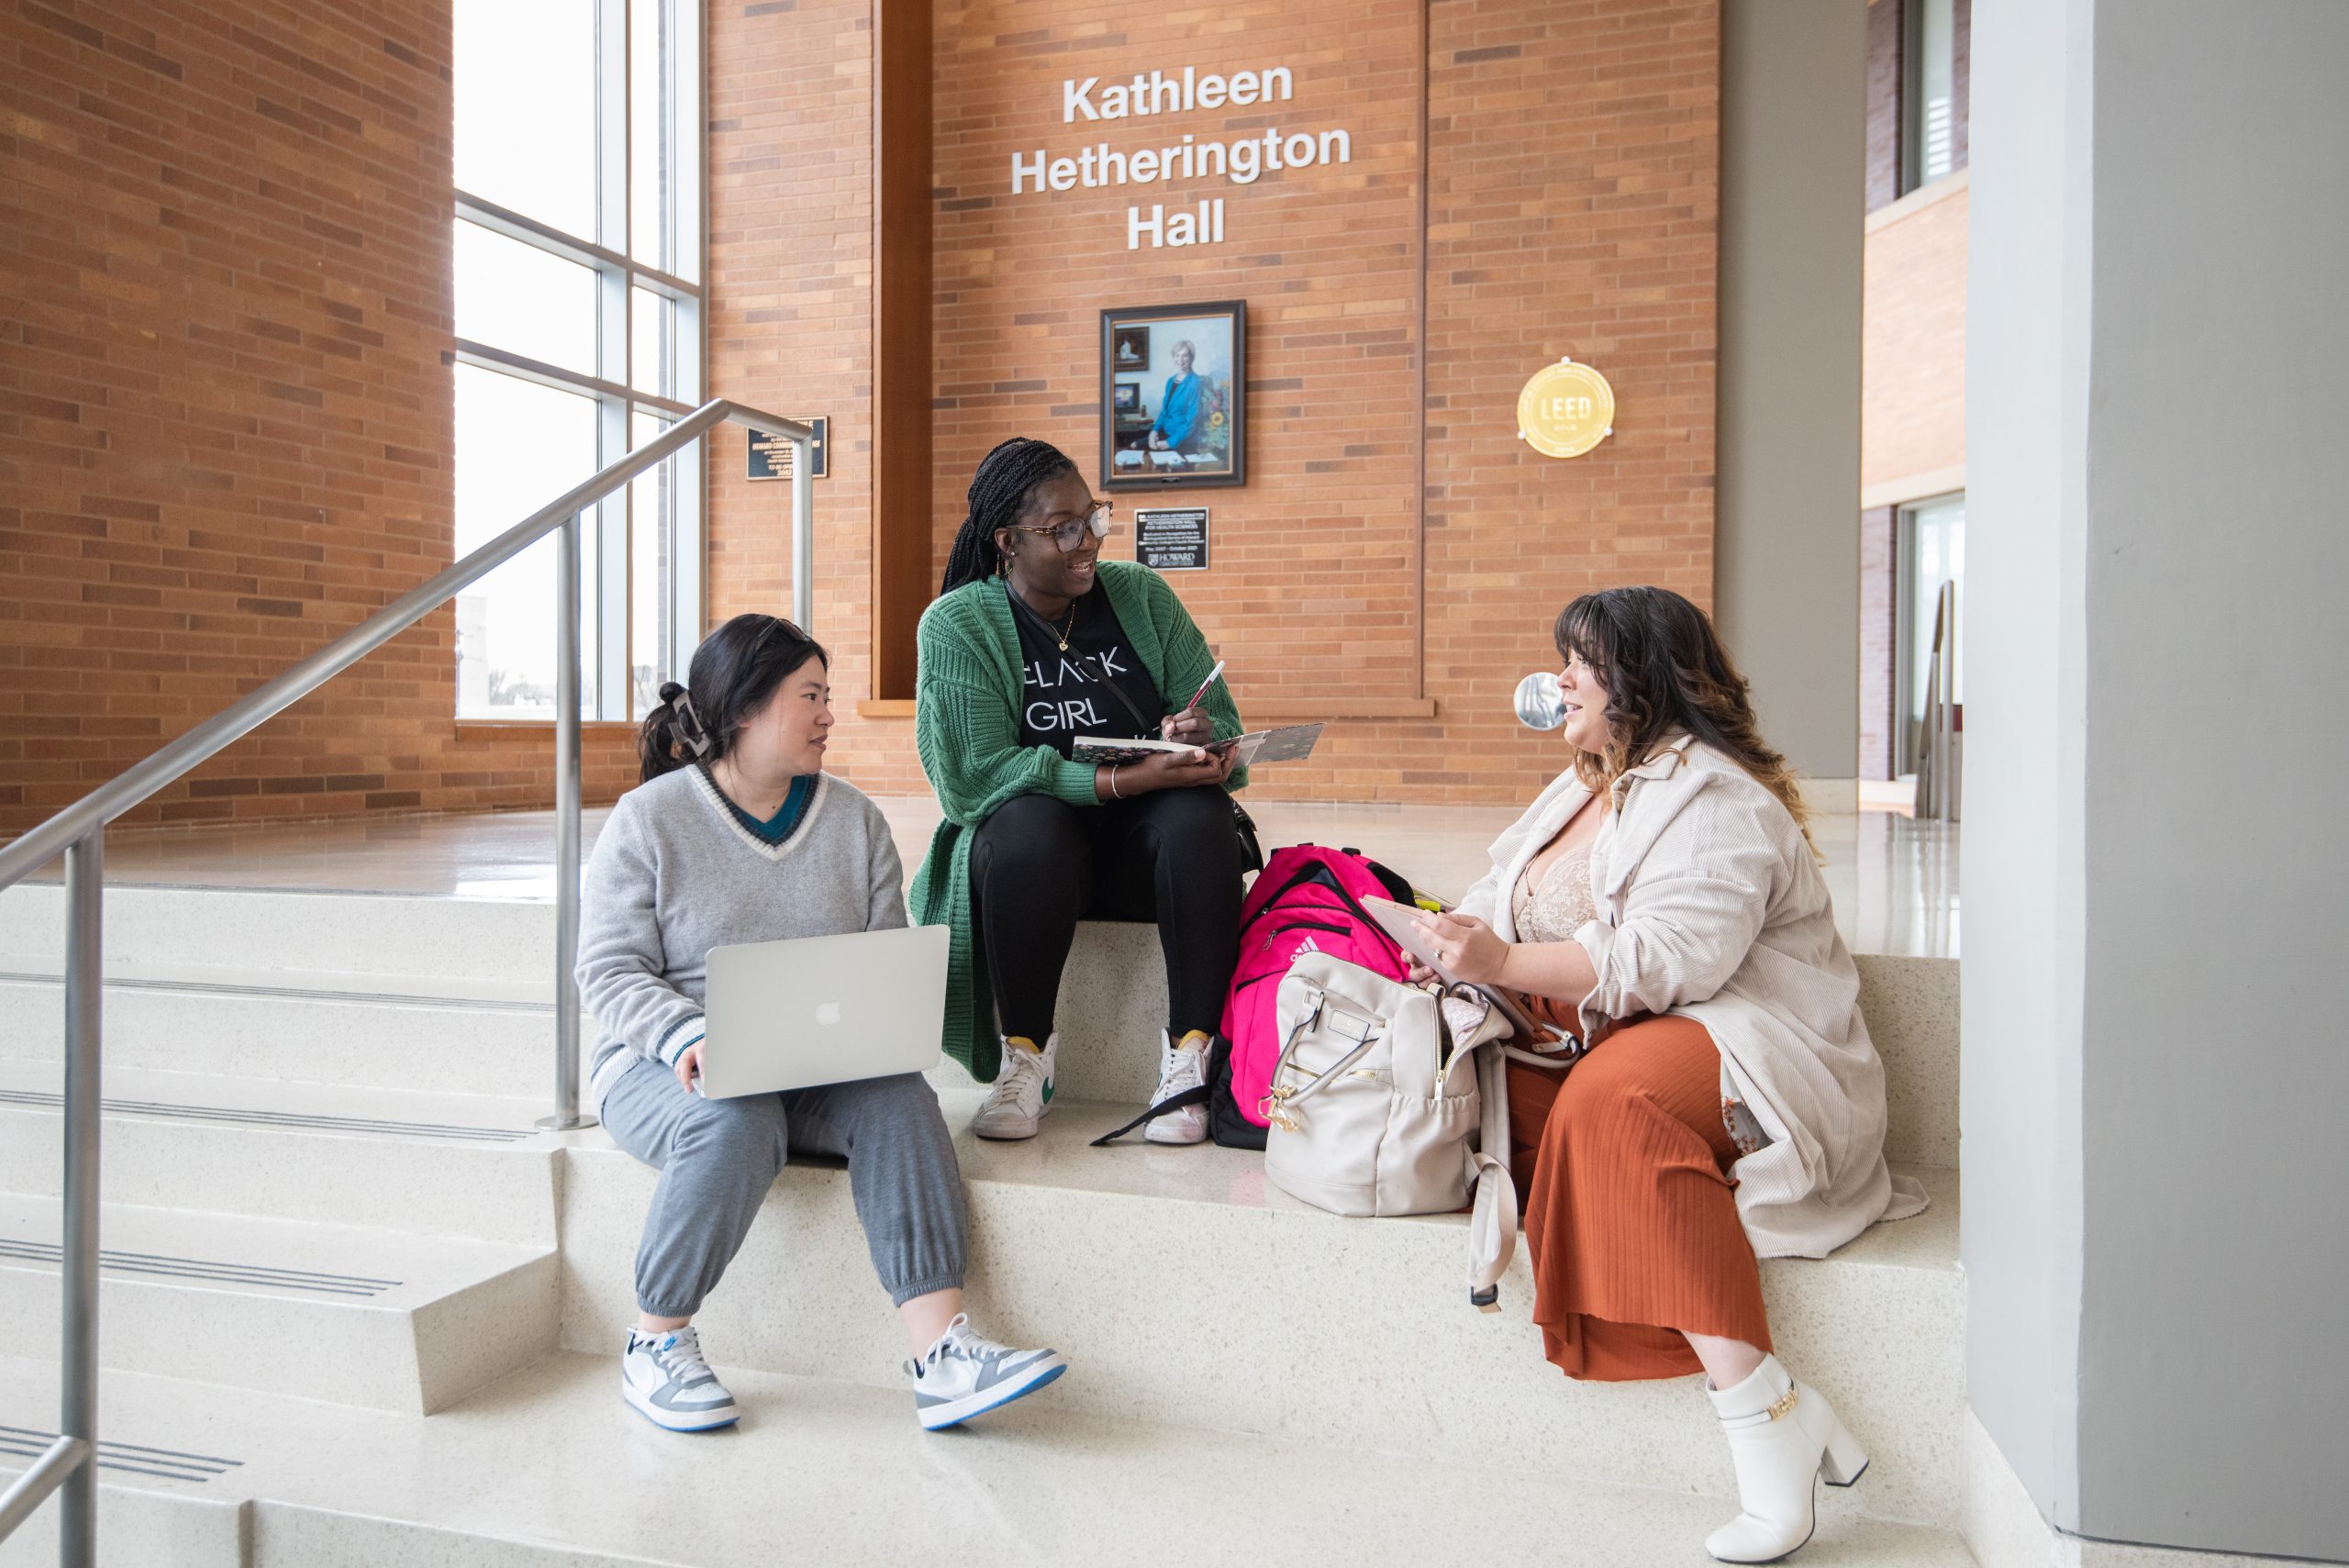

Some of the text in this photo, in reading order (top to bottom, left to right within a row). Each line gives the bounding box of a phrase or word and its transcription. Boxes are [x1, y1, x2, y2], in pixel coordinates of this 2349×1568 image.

[1063, 66, 1293, 123] Kathleen
[1011, 128, 1351, 195] Hetherington
[1128, 198, 1225, 250] Hall
[1541, 396, 1591, 421] LEED
[1026, 697, 1108, 731] GIRL
